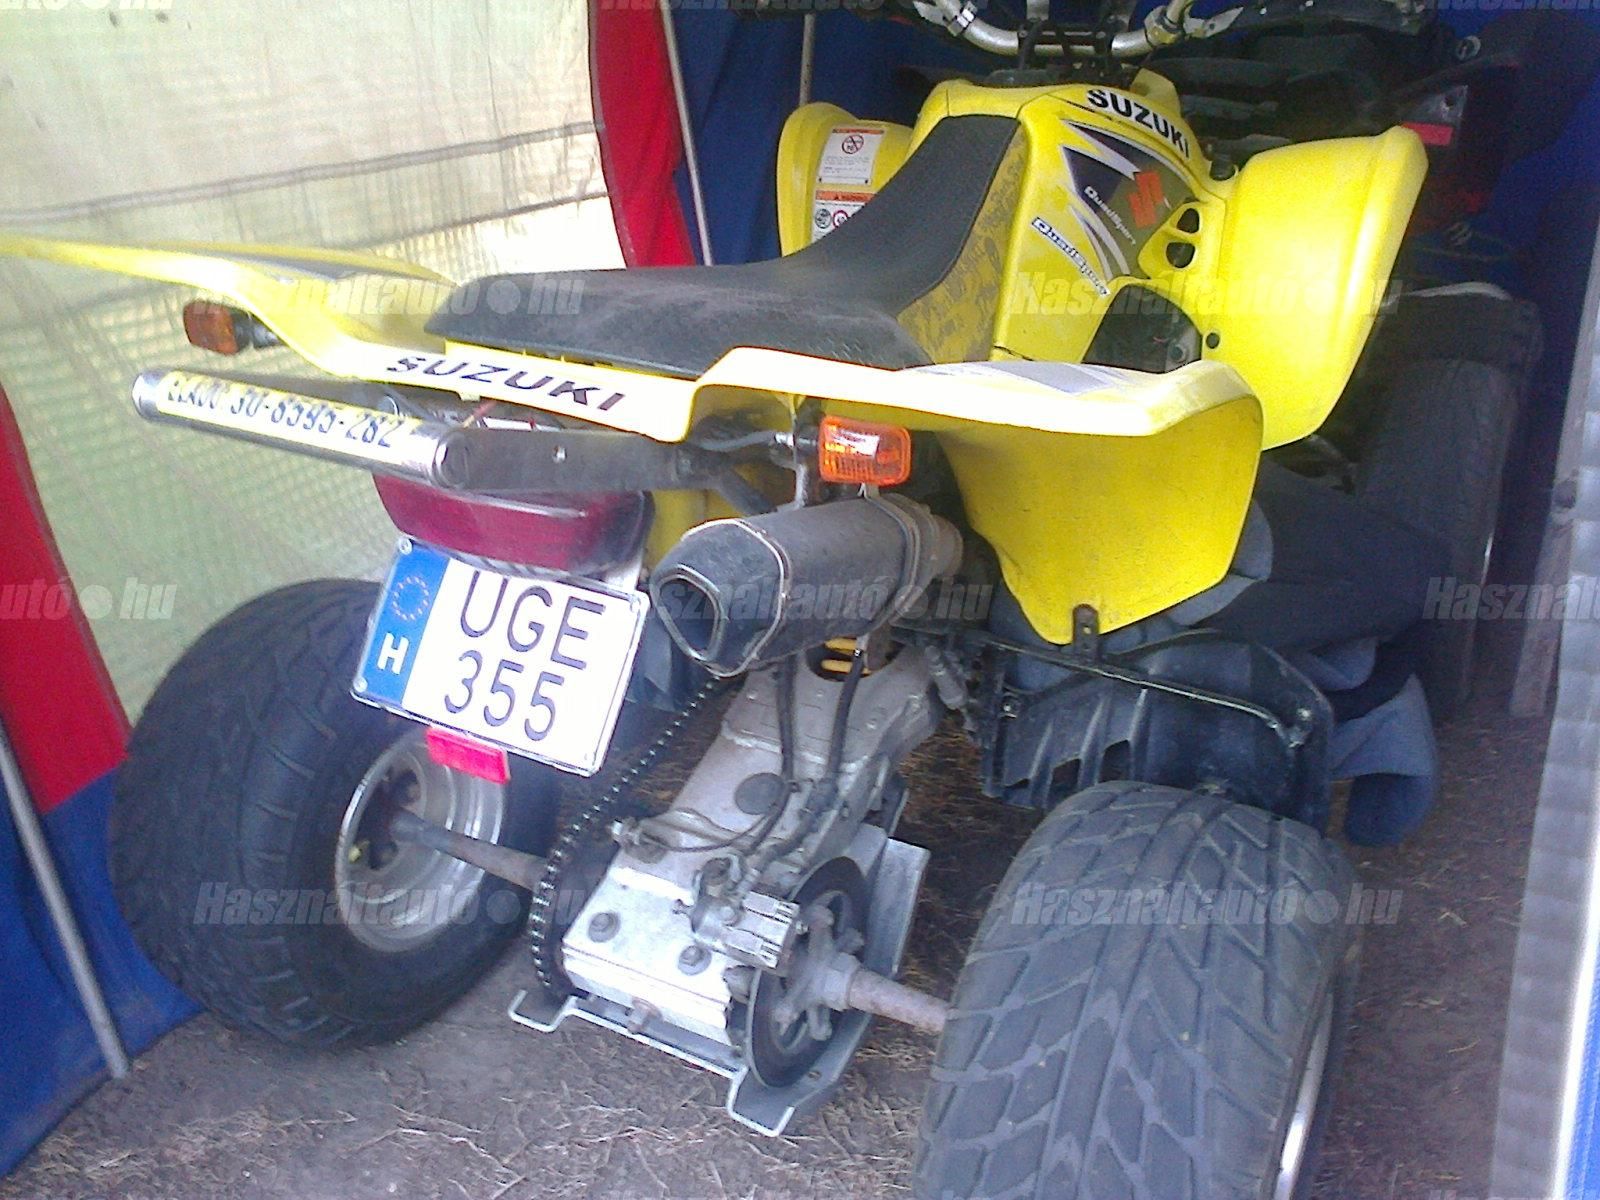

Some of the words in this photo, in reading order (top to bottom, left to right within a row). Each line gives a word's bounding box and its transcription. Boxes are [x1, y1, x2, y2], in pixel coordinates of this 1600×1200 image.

[1086, 88, 1190, 159] SUZUKI
[386, 355, 625, 411] SUZUKI
[376, 632, 409, 675] H
[459, 569, 607, 671] UGE
[444, 649, 565, 742] 355
